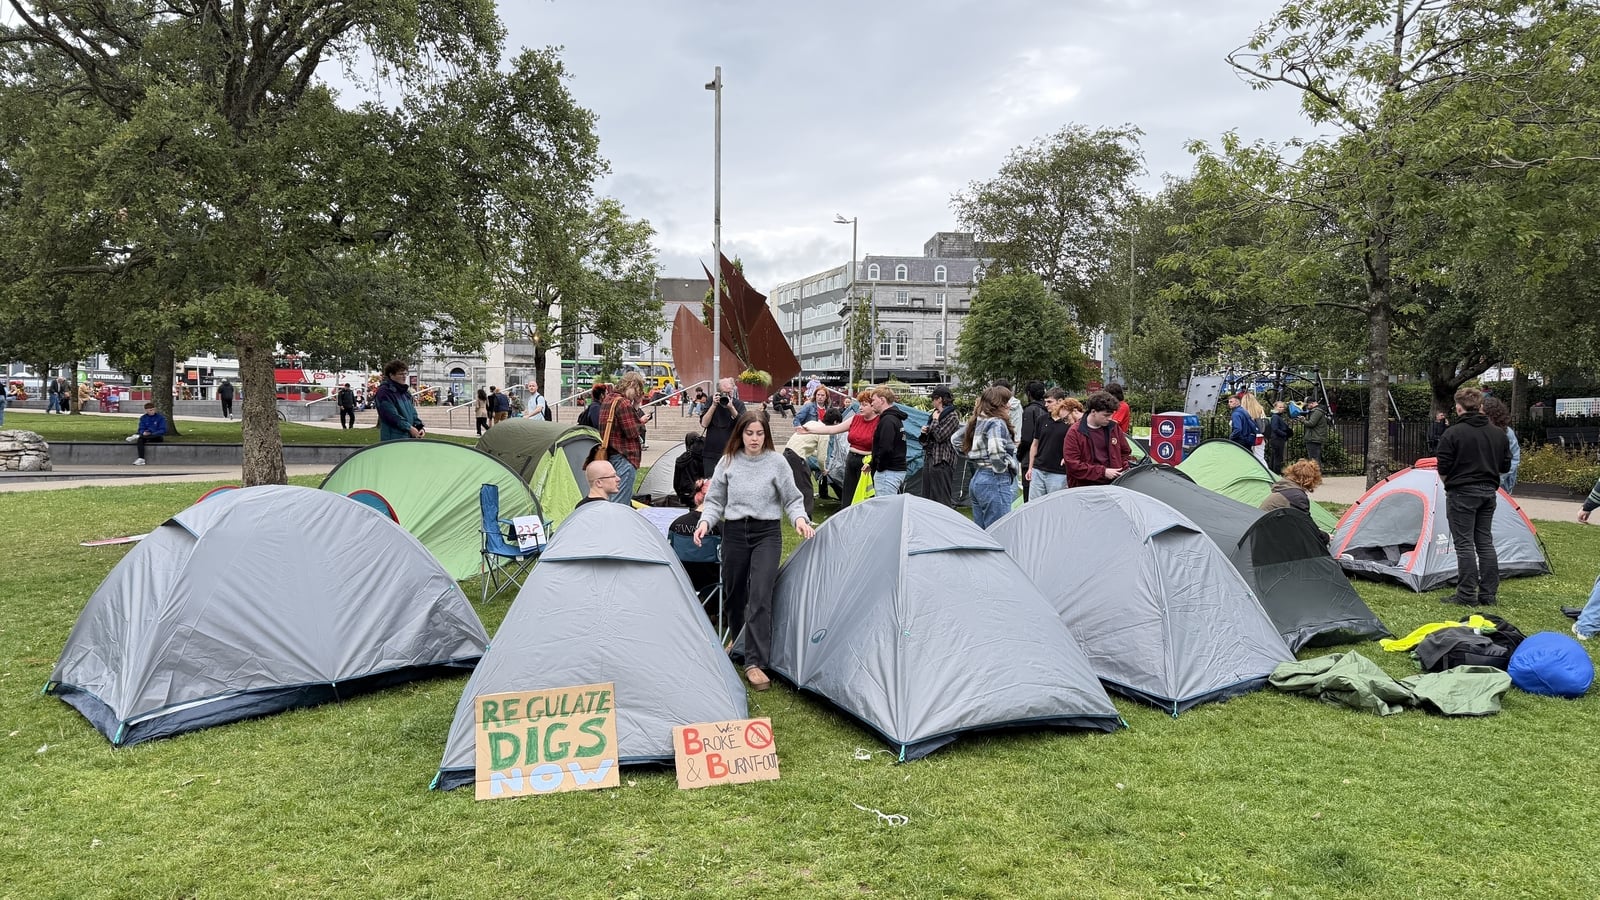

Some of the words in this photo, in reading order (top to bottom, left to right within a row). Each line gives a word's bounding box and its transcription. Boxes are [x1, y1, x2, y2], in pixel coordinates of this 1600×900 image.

[482, 690, 612, 731] REGULATE
[714, 722, 743, 734] We're
[487, 716, 608, 771] DIGS
[489, 758, 615, 797] NOW
[686, 757, 703, 783] &
